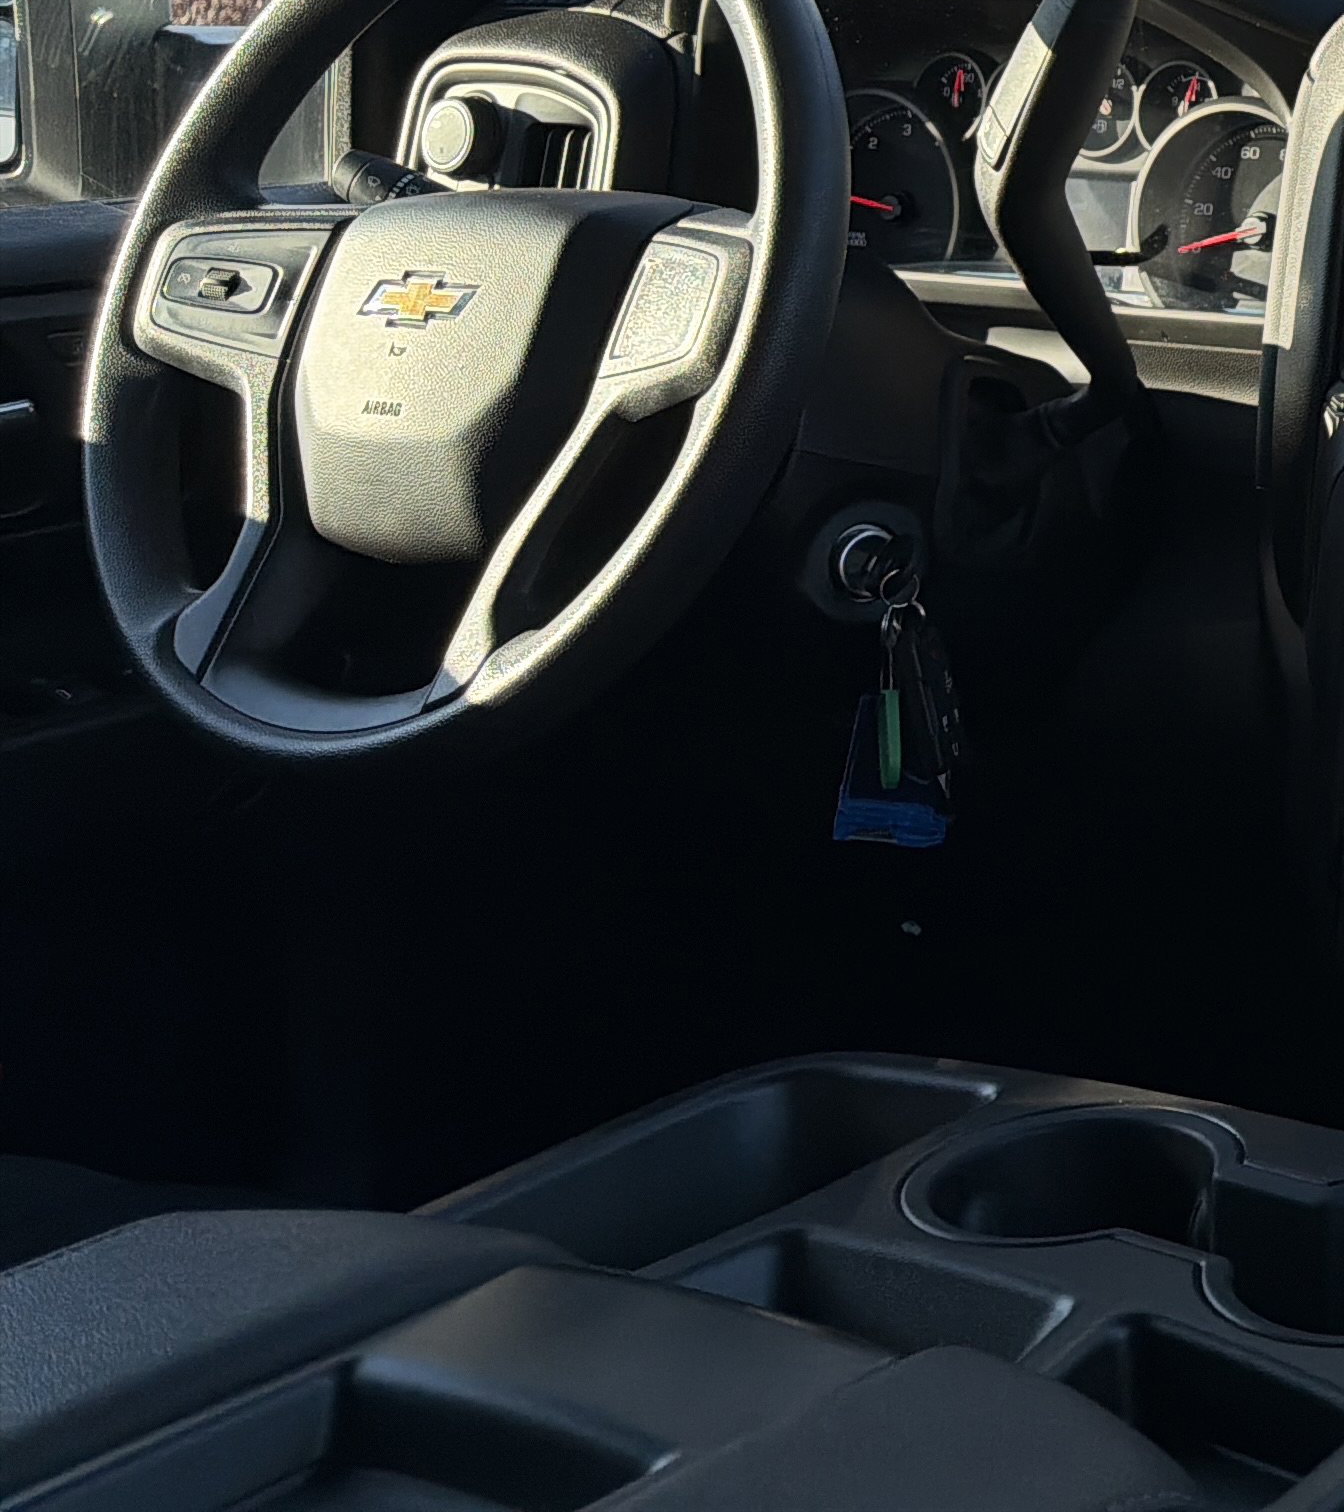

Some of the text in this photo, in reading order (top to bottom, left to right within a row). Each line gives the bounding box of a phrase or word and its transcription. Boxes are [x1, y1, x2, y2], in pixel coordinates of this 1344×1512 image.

[903, 124, 912, 137] 3
[868, 136, 878, 150] 2
[1241, 146, 1260, 160] 60
[1212, 166, 1232, 180] 40
[1194, 203, 1214, 216] 20
[361, 399, 403, 417] AIRBAG
